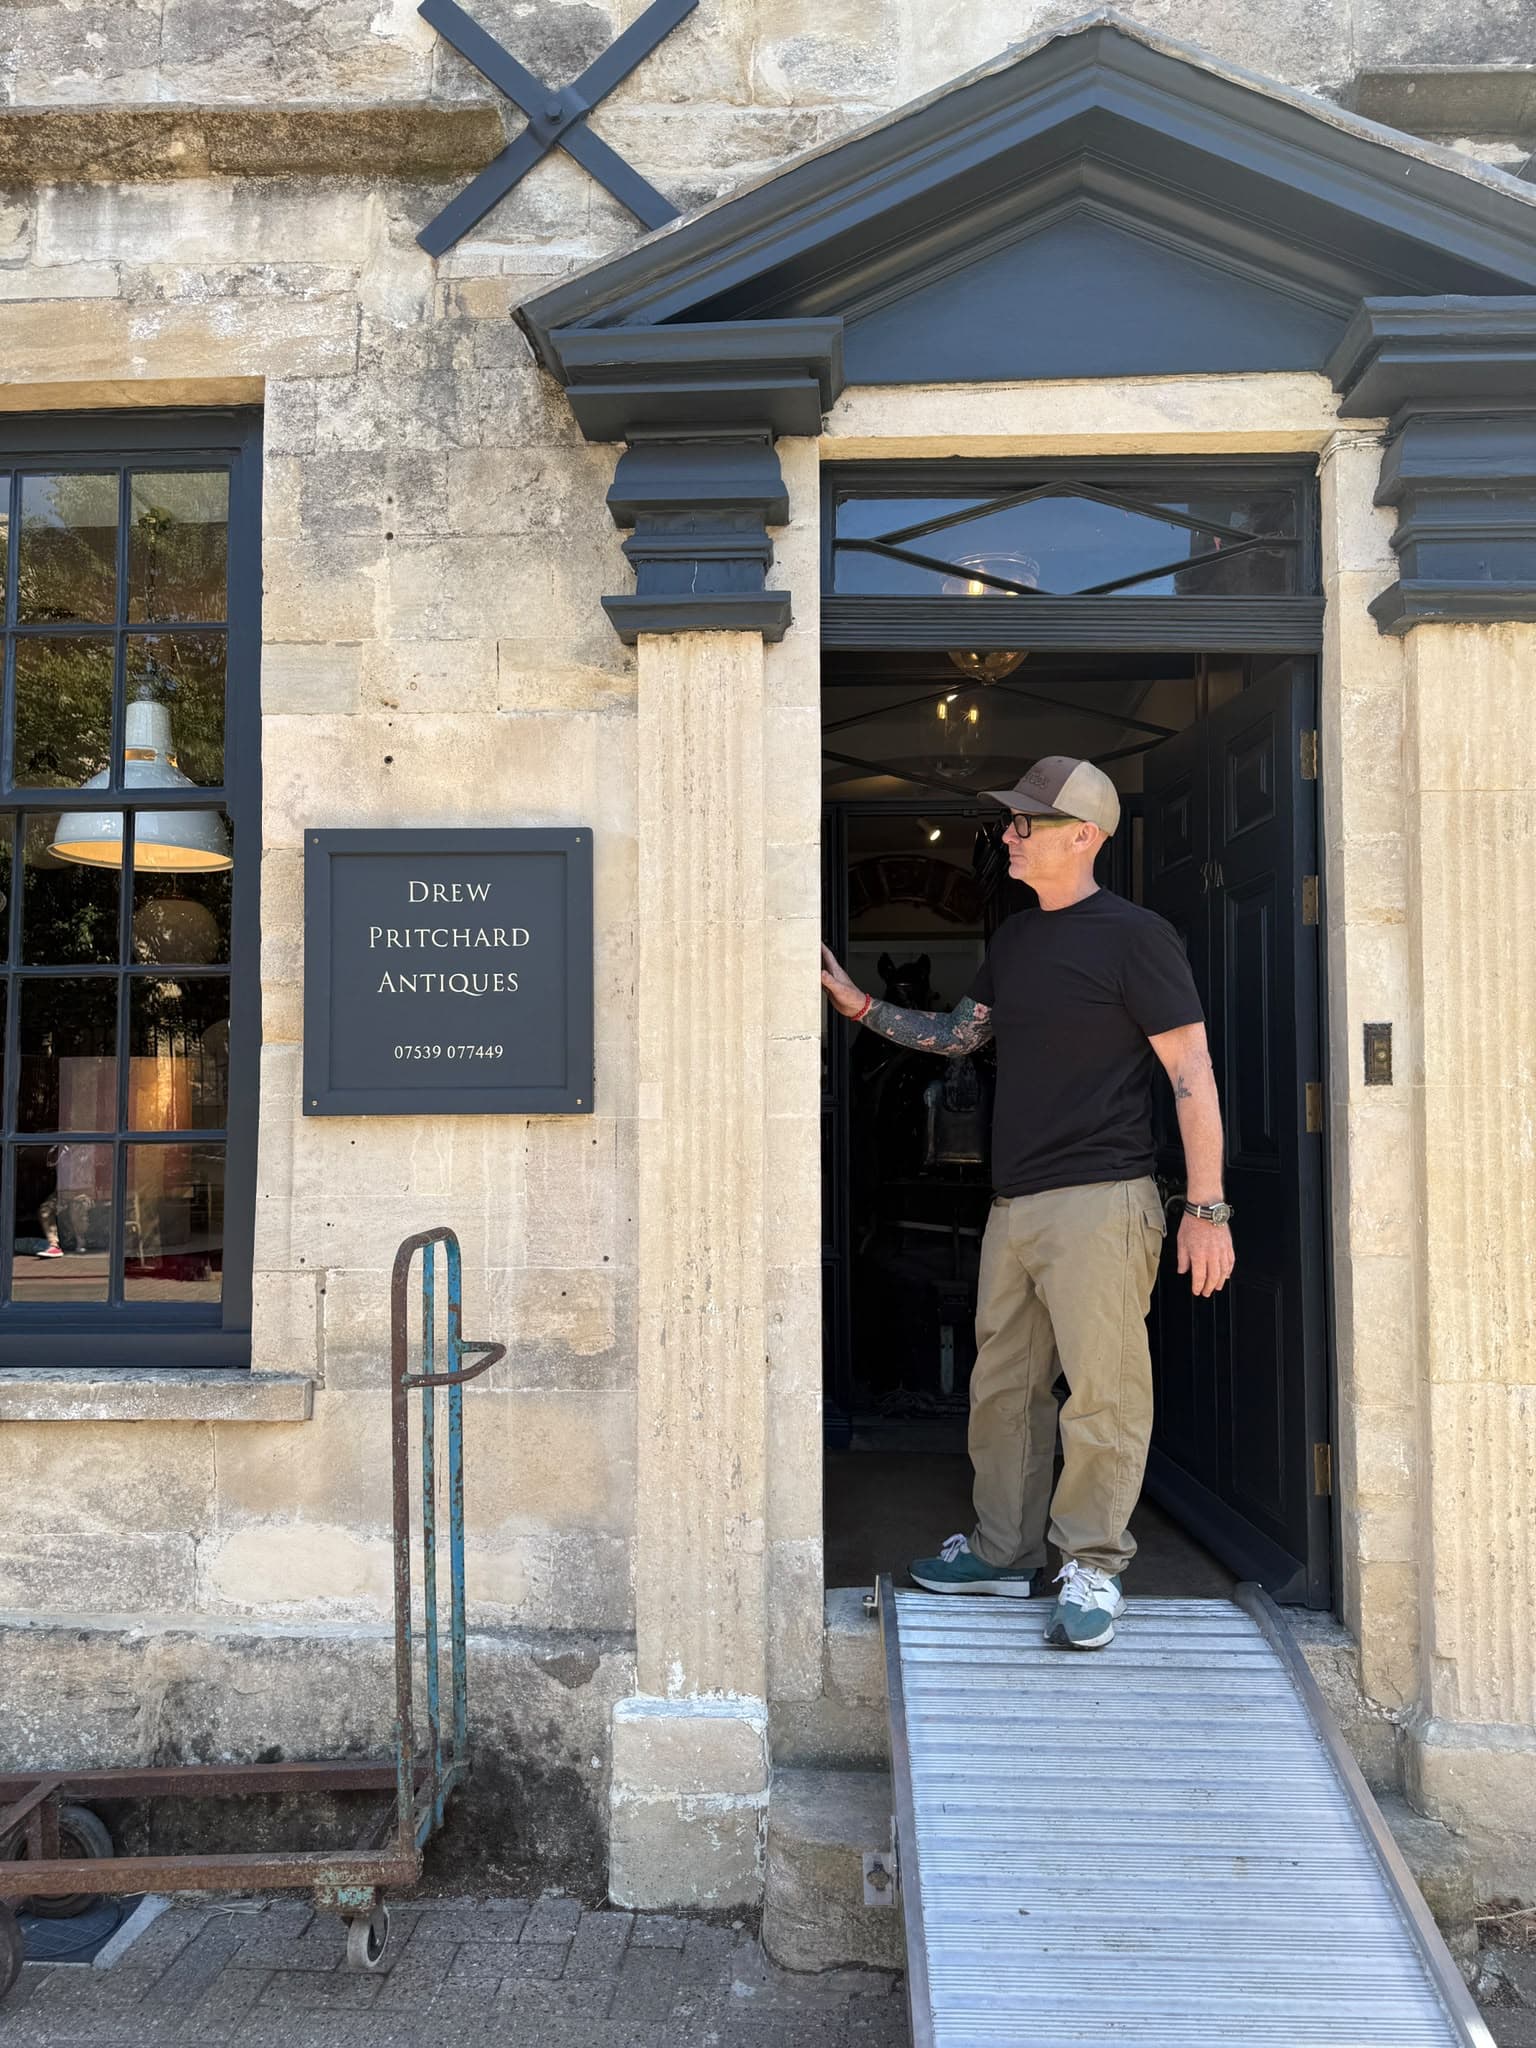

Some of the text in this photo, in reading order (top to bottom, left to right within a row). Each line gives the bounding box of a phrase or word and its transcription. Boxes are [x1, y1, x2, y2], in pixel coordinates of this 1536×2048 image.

[408, 880, 492, 903] DREW
[369, 926, 530, 949] PRITCHARD
[377, 970, 520, 997] ANTIQUES
[394, 1045, 504, 1060] 07539 077449
